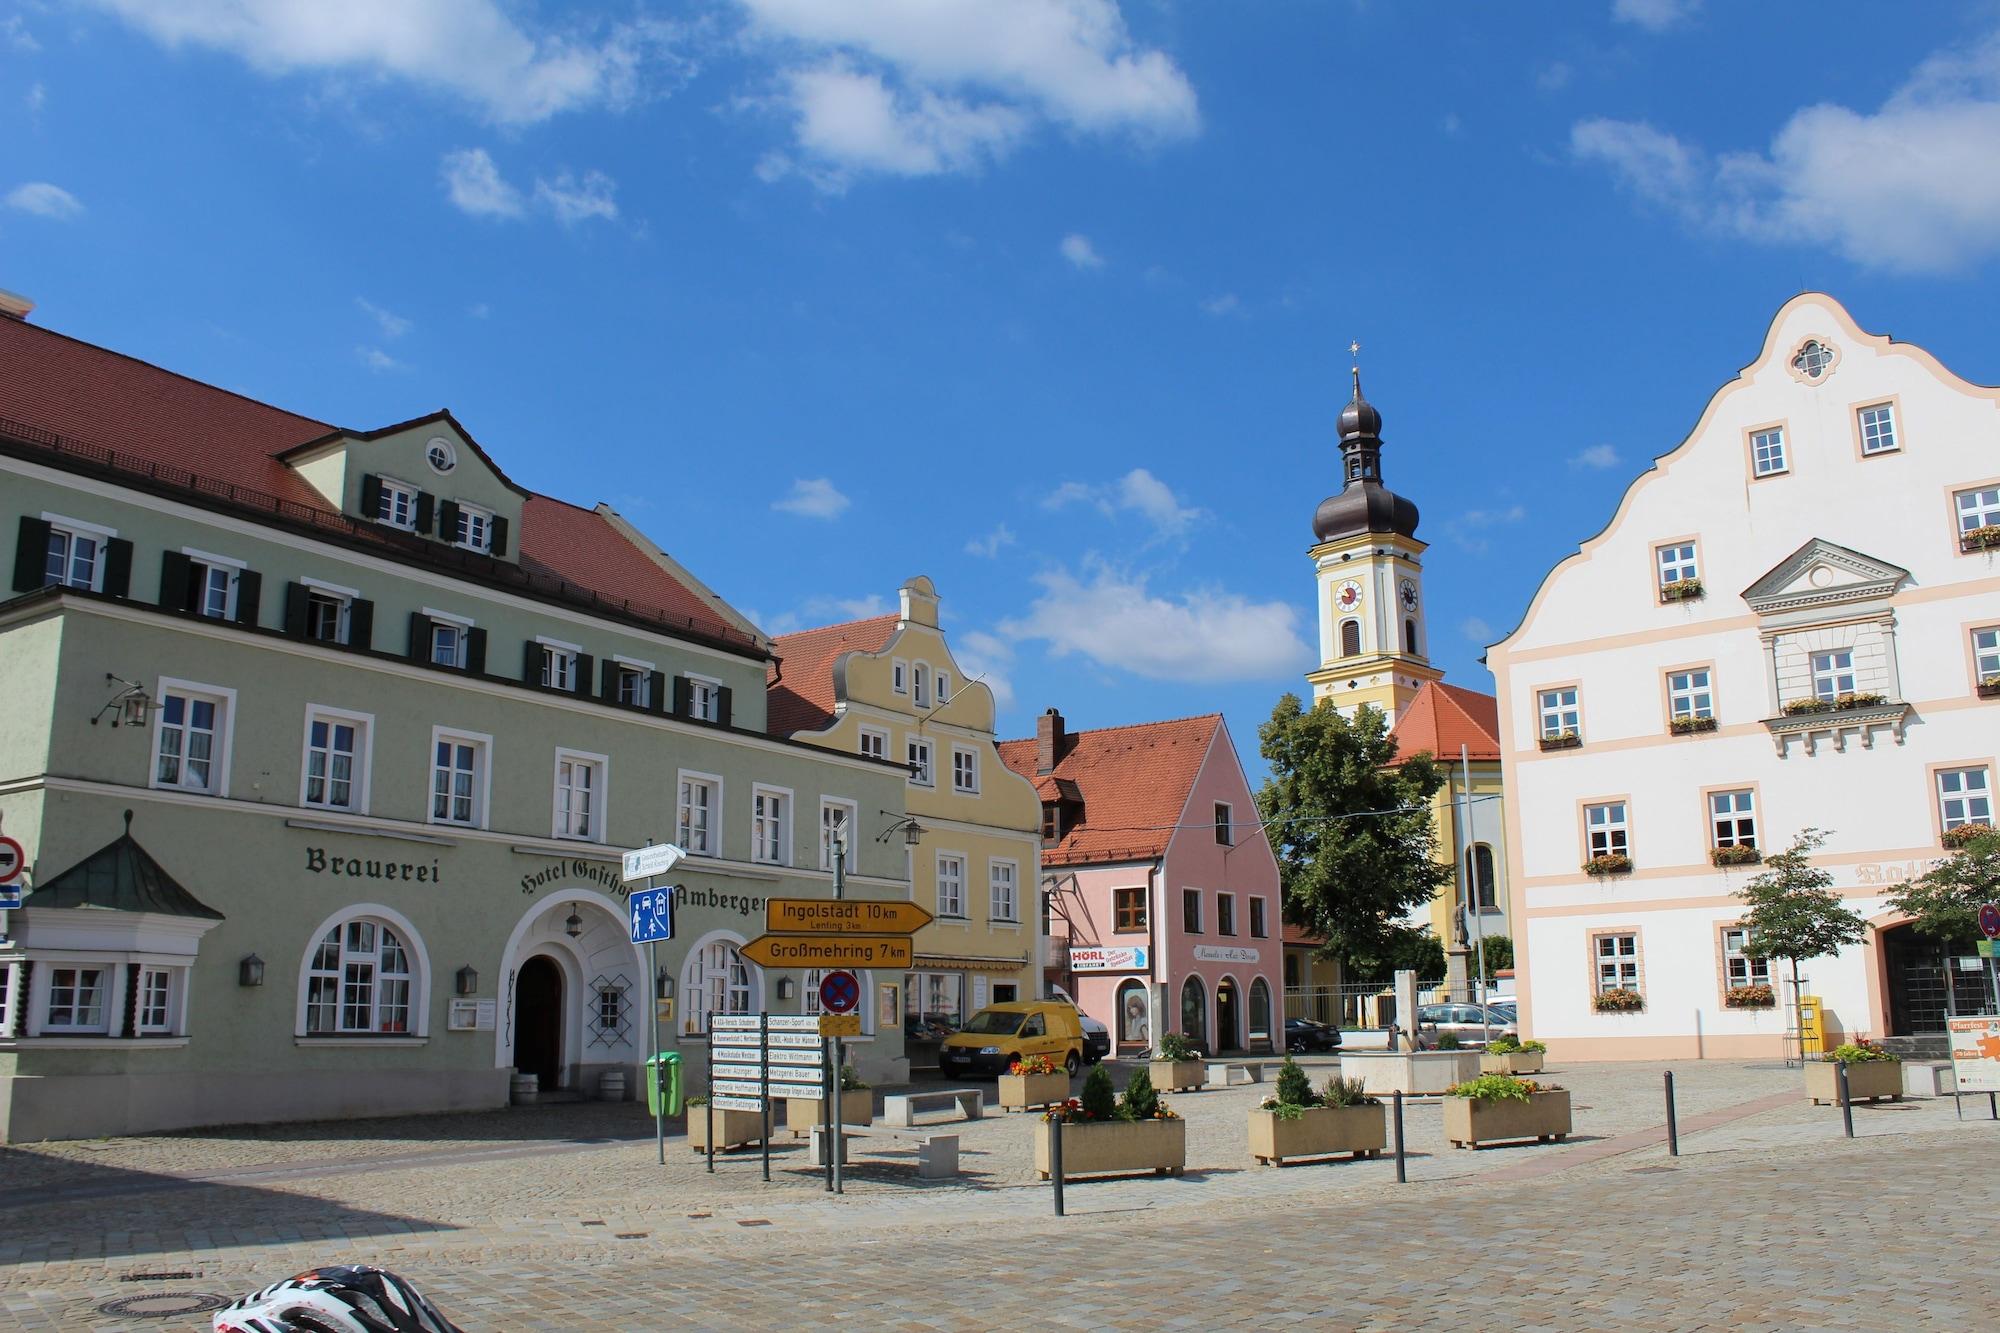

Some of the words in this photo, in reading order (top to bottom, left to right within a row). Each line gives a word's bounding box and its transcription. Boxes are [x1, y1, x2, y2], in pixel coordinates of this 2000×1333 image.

[305, 846, 440, 883] Brauerei
[521, 860, 566, 896] Hotel
[783, 902, 859, 921] Ingolstadt
[866, 904, 881, 919] 10
[883, 907, 898, 919] km
[810, 921, 843, 931] Lenting
[770, 943, 873, 961] Großmehring
[880, 944, 888, 958] 7
[890, 947, 905, 959] km
[1072, 951, 1105, 961] HÖRL
[1951, 1021, 1984, 1030] Pfarrfest
[768, 1051, 787, 1060] Elektro
[769, 1068, 795, 1079] Metzgerei
[795, 1070, 810, 1078] Bauer
